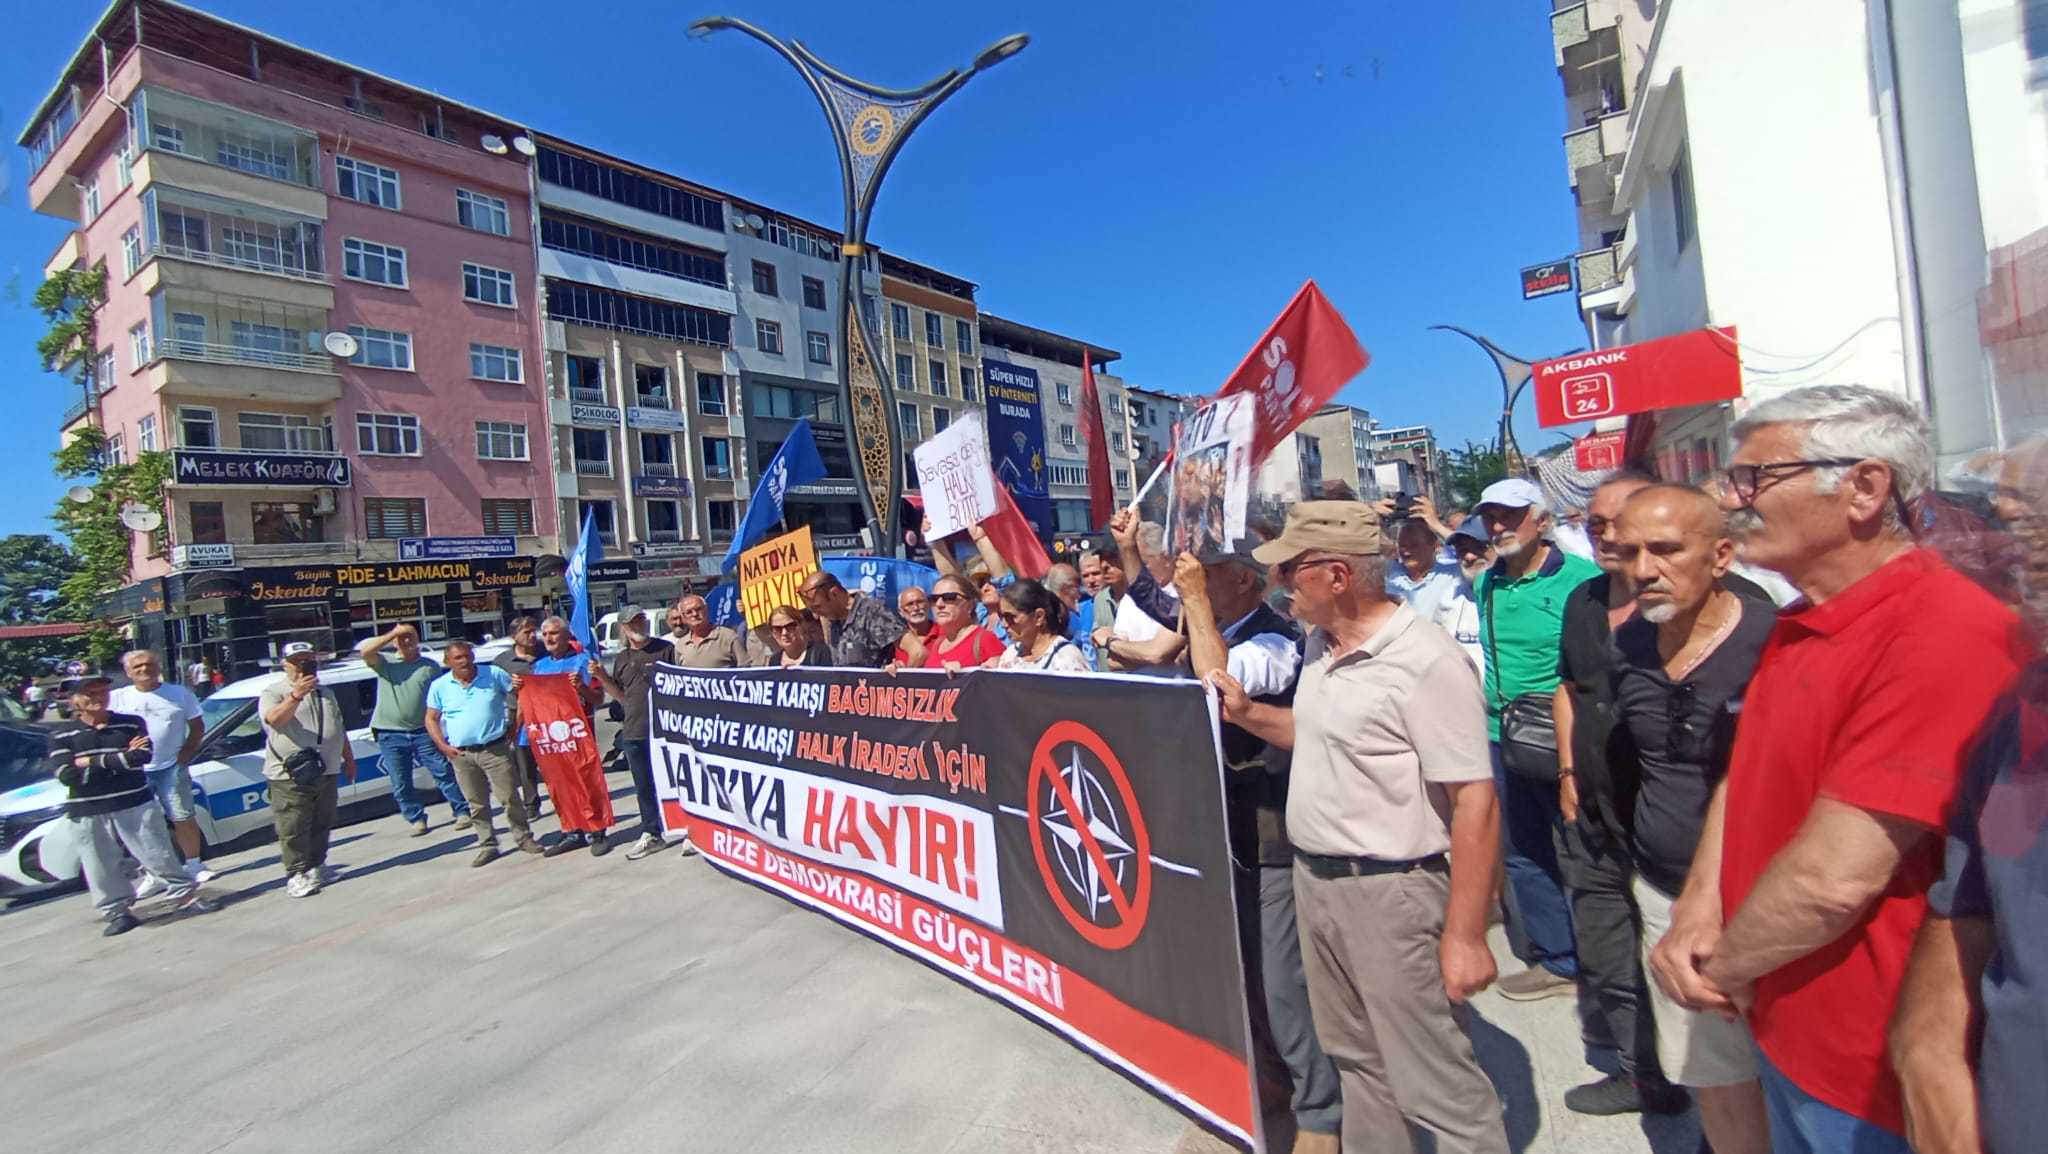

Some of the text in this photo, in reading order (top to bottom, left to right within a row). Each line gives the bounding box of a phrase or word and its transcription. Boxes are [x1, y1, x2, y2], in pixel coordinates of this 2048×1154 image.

[1541, 351, 1627, 376] AKBANK
[990, 367, 1015, 384] SÜPER
[575, 407, 618, 420] PSİKOLOG
[1000, 403, 1031, 419] BURADA
[1576, 397, 1599, 413] 24
[180, 457, 326, 479] MELEK KUAFÖR
[743, 541, 799, 582] NATOYA
[337, 566, 375, 584] PİDE
[388, 563, 470, 582] LAHMACUN
[777, 682, 826, 718] KARŞI
[828, 679, 960, 722] BAĞIMSIZLIK
[742, 724, 794, 762] KARŞI
[797, 731, 847, 767] HALK
[803, 786, 979, 901] HAYIR!
[713, 829, 1064, 1011] RİZE DEMOKRASİ GÜÇLERİ
